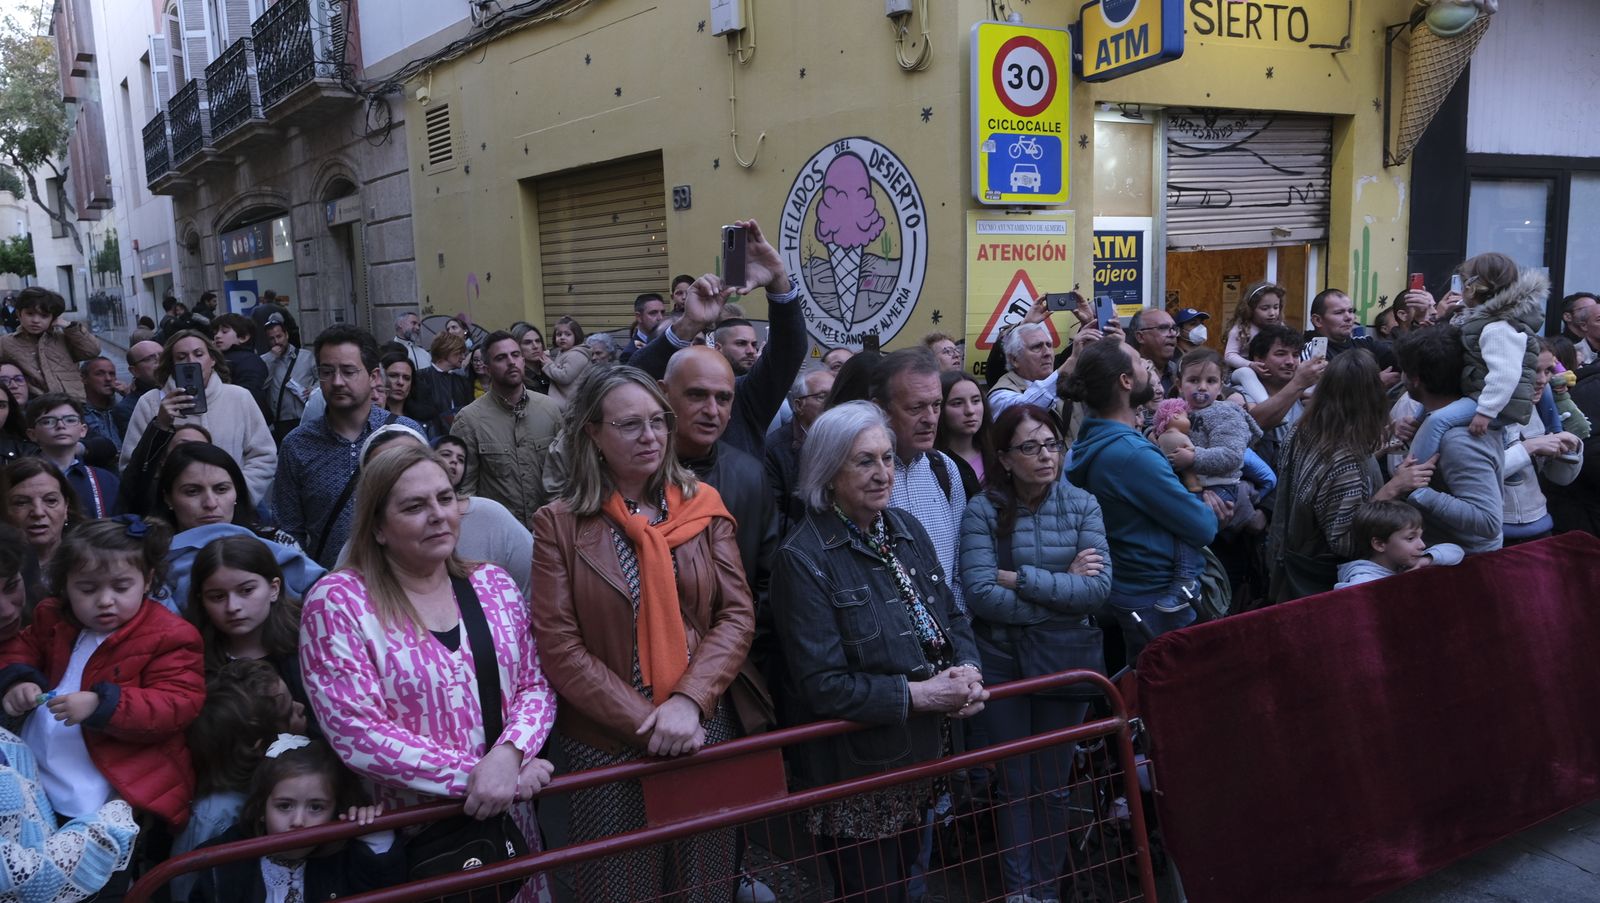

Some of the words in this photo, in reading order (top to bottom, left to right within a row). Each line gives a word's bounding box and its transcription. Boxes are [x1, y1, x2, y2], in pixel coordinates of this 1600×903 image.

[1184, 0, 1309, 42] SIERTO
[1095, 23, 1148, 70] ATM
[1007, 63, 1044, 91] 30
[988, 119, 1061, 133] CICLOCALLE
[785, 160, 824, 251] HELADOS
[834, 141, 851, 154] DEL
[869, 148, 921, 229] DESIERTO
[977, 240, 1067, 261] ATENCIÓN
[1093, 264, 1137, 286] ajero
[230, 290, 257, 315] P
[788, 273, 815, 323] HADOS
[881, 287, 912, 332] ALMERÍA
[973, 361, 988, 375] CE
